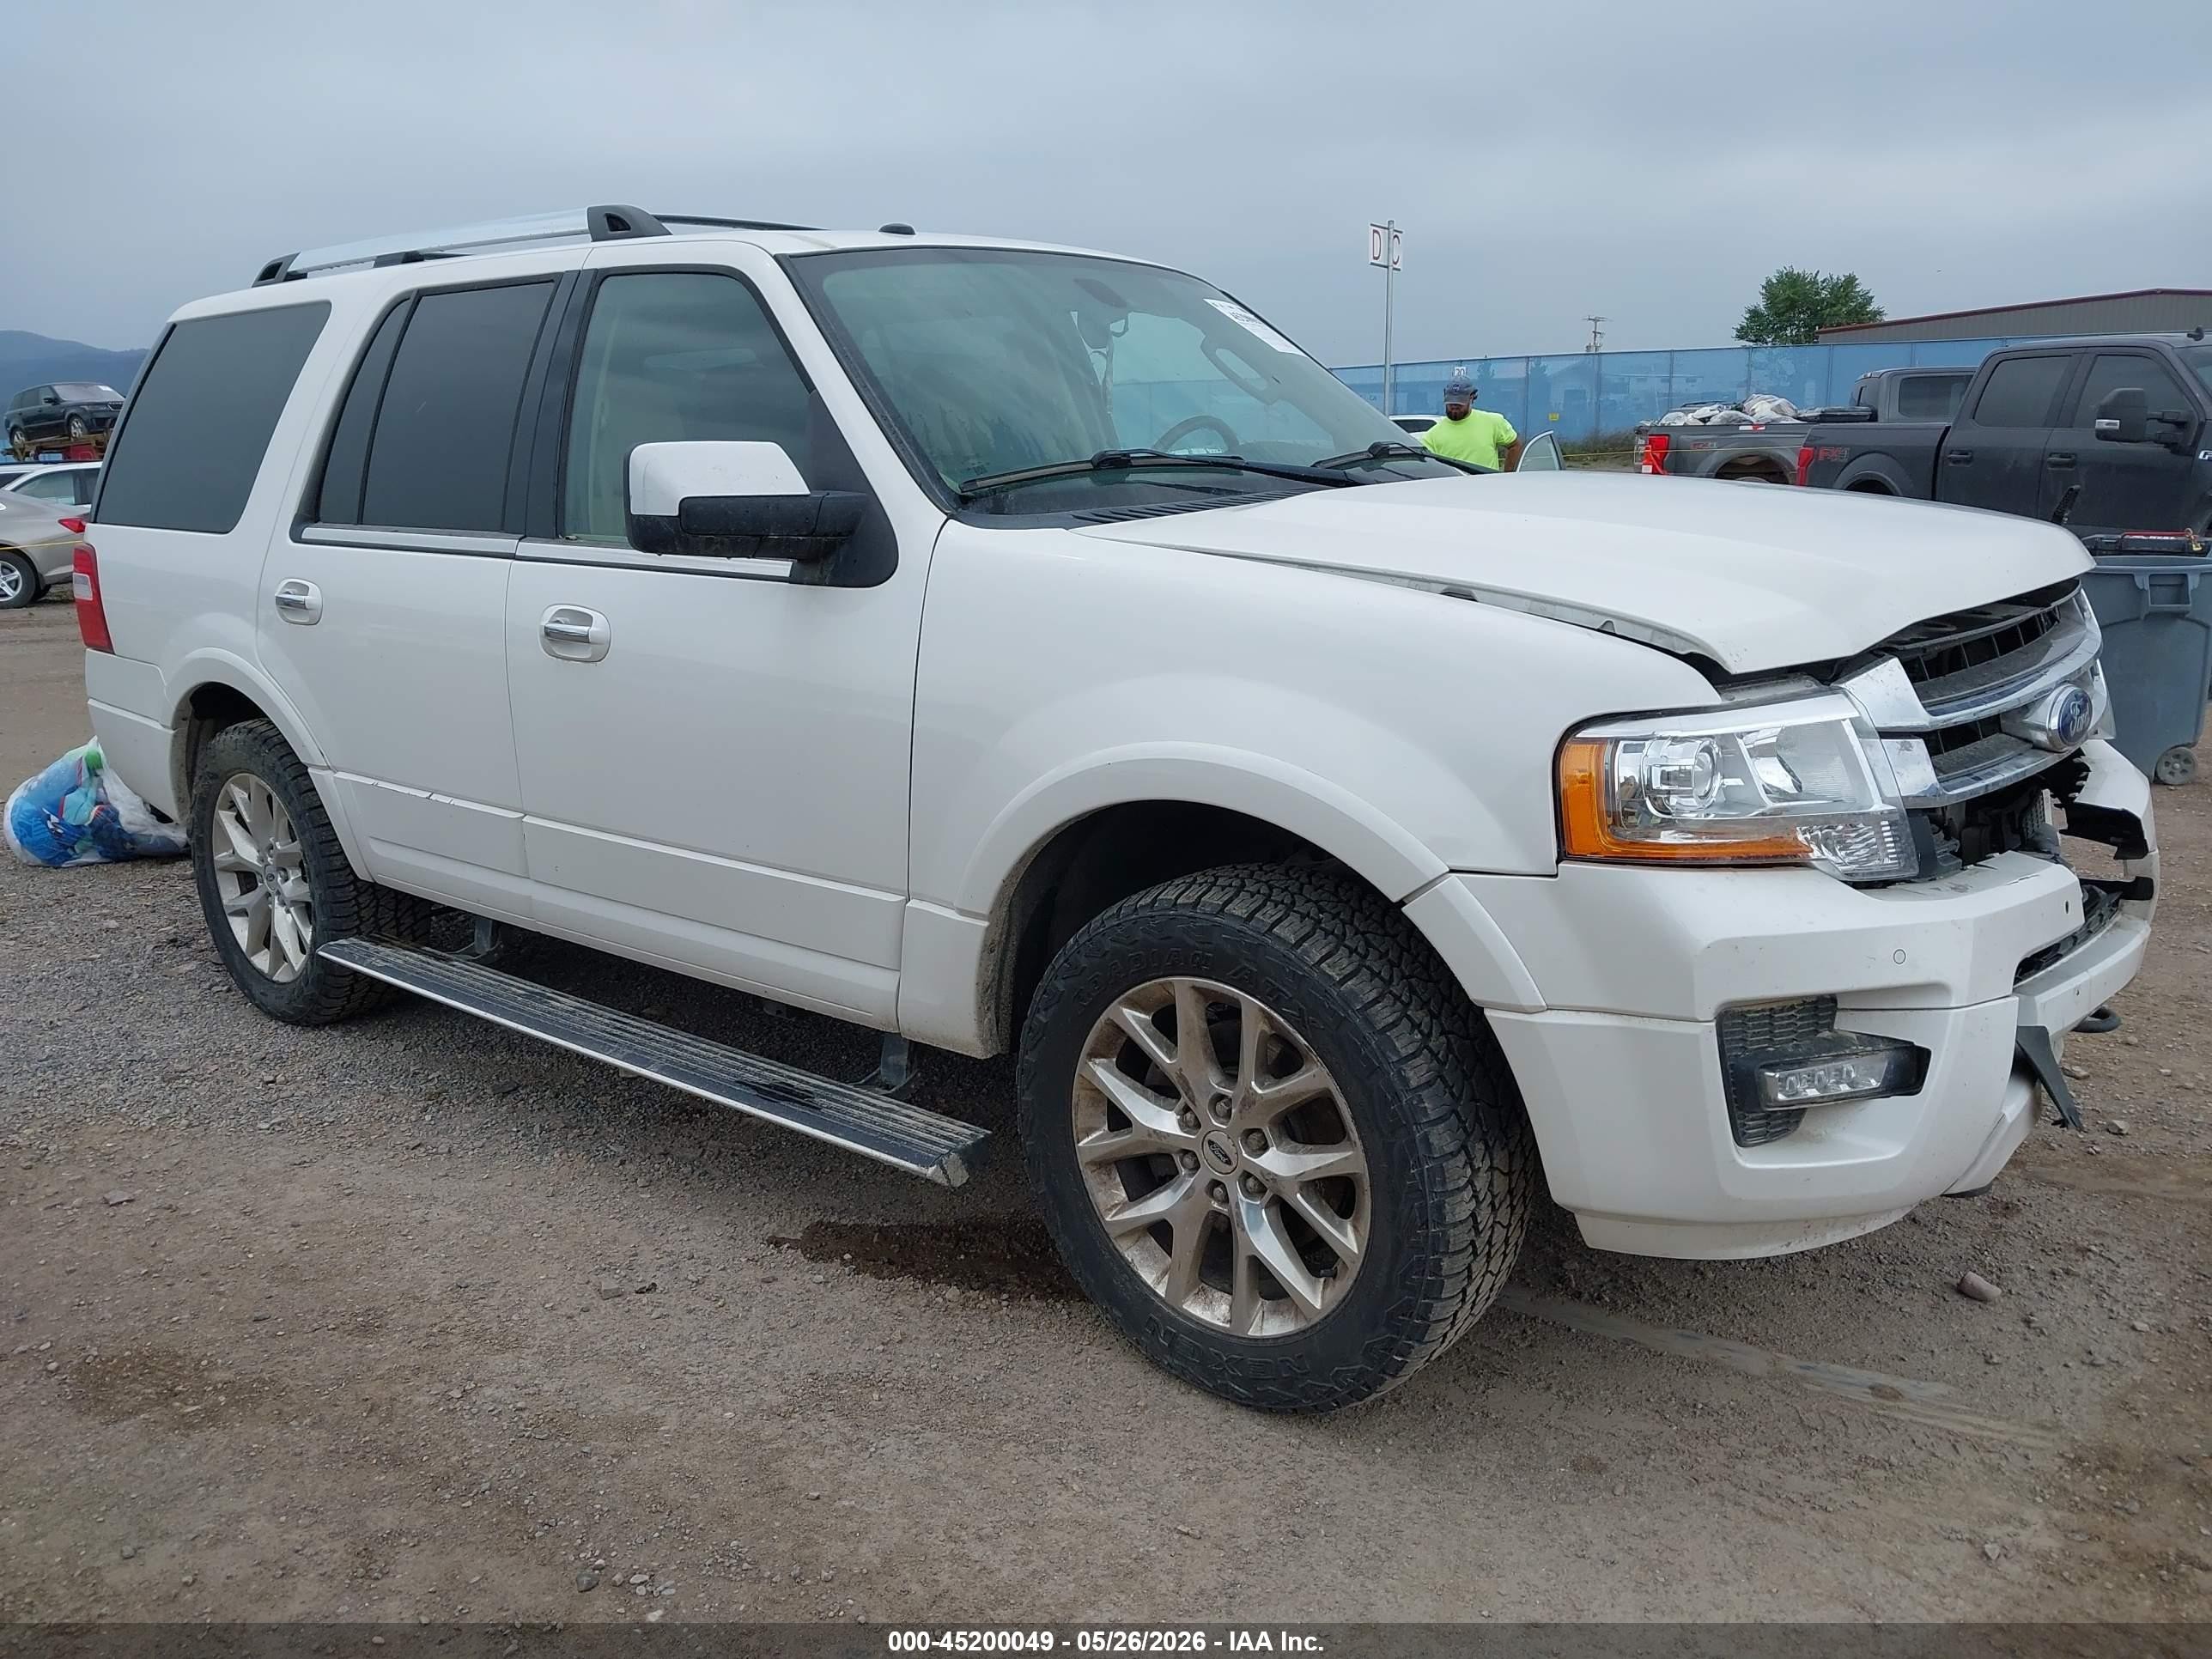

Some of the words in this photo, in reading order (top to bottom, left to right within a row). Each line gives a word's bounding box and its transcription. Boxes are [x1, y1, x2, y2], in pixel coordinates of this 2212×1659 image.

[1372, 229, 1382, 260] D
[2069, 697, 2089, 737] Ford
[1209, 1142, 1230, 1164] Ford
